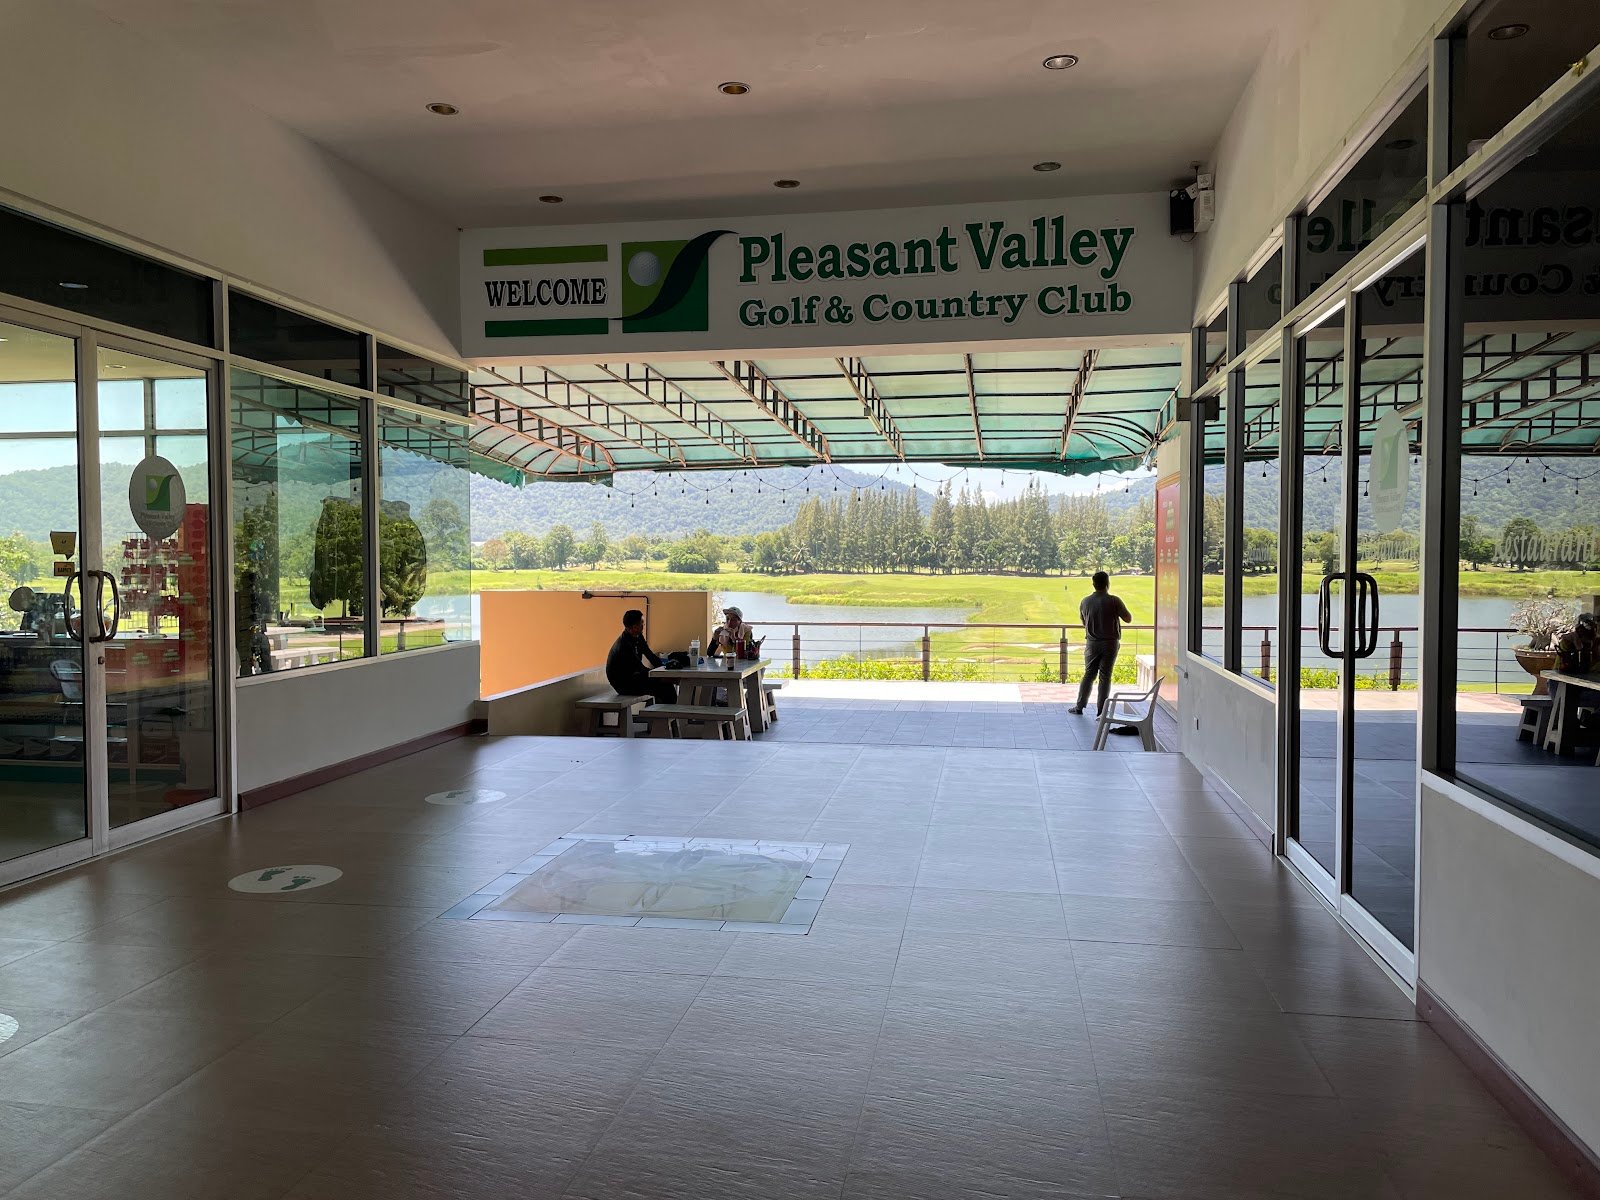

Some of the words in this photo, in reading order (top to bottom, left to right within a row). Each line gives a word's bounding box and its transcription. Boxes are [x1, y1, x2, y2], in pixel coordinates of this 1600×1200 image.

[738, 226, 959, 283] Pleasant
[965, 215, 1135, 280] Valley
[484, 277, 607, 307] WELCOME
[738, 295, 822, 327] Golf
[823, 295, 854, 325] &
[862, 289, 1029, 324] Country
[1037, 282, 1132, 315] Club
